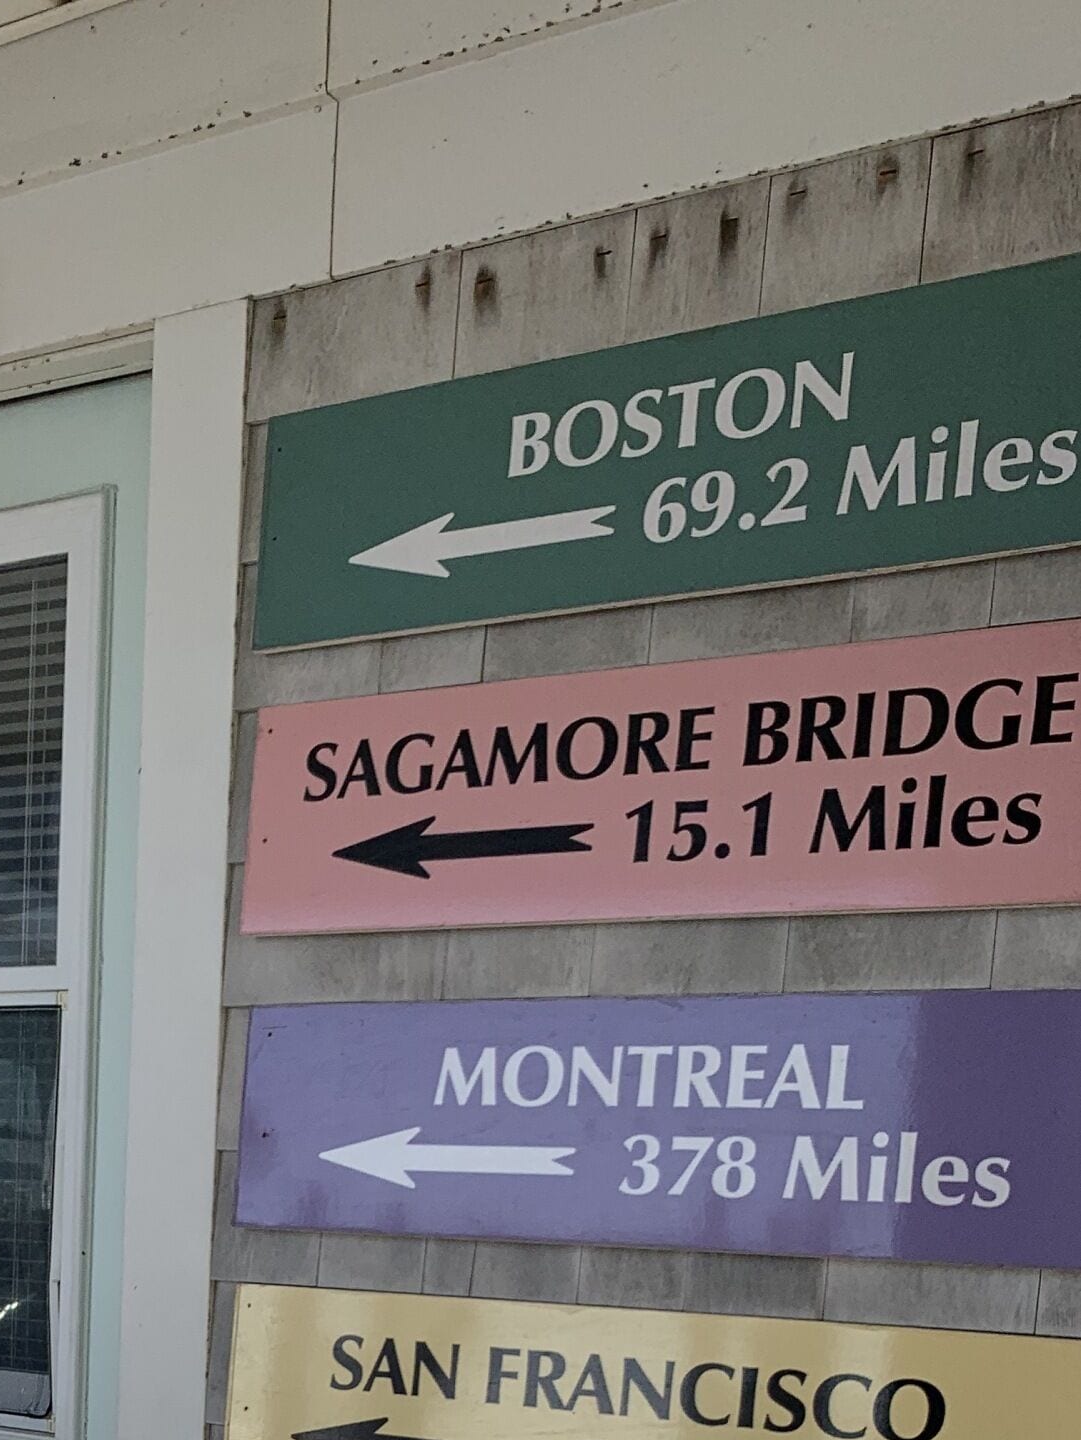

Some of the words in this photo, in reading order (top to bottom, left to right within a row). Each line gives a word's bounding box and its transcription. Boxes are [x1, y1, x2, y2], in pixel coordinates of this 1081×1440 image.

[506, 351, 856, 479] BOSTON
[643, 457, 809, 544] 69.2
[835, 418, 1079, 516] Miles
[302, 705, 717, 803] SAGAMORE
[741, 672, 1080, 768] BRIDGE
[625, 791, 774, 864] 15.1
[808, 773, 1043, 855] Miles
[432, 1042, 864, 1111] MONTREAL
[618, 1134, 757, 1199] 378
[782, 1131, 1012, 1208] Miles
[329, 1334, 461, 1401] SAN
